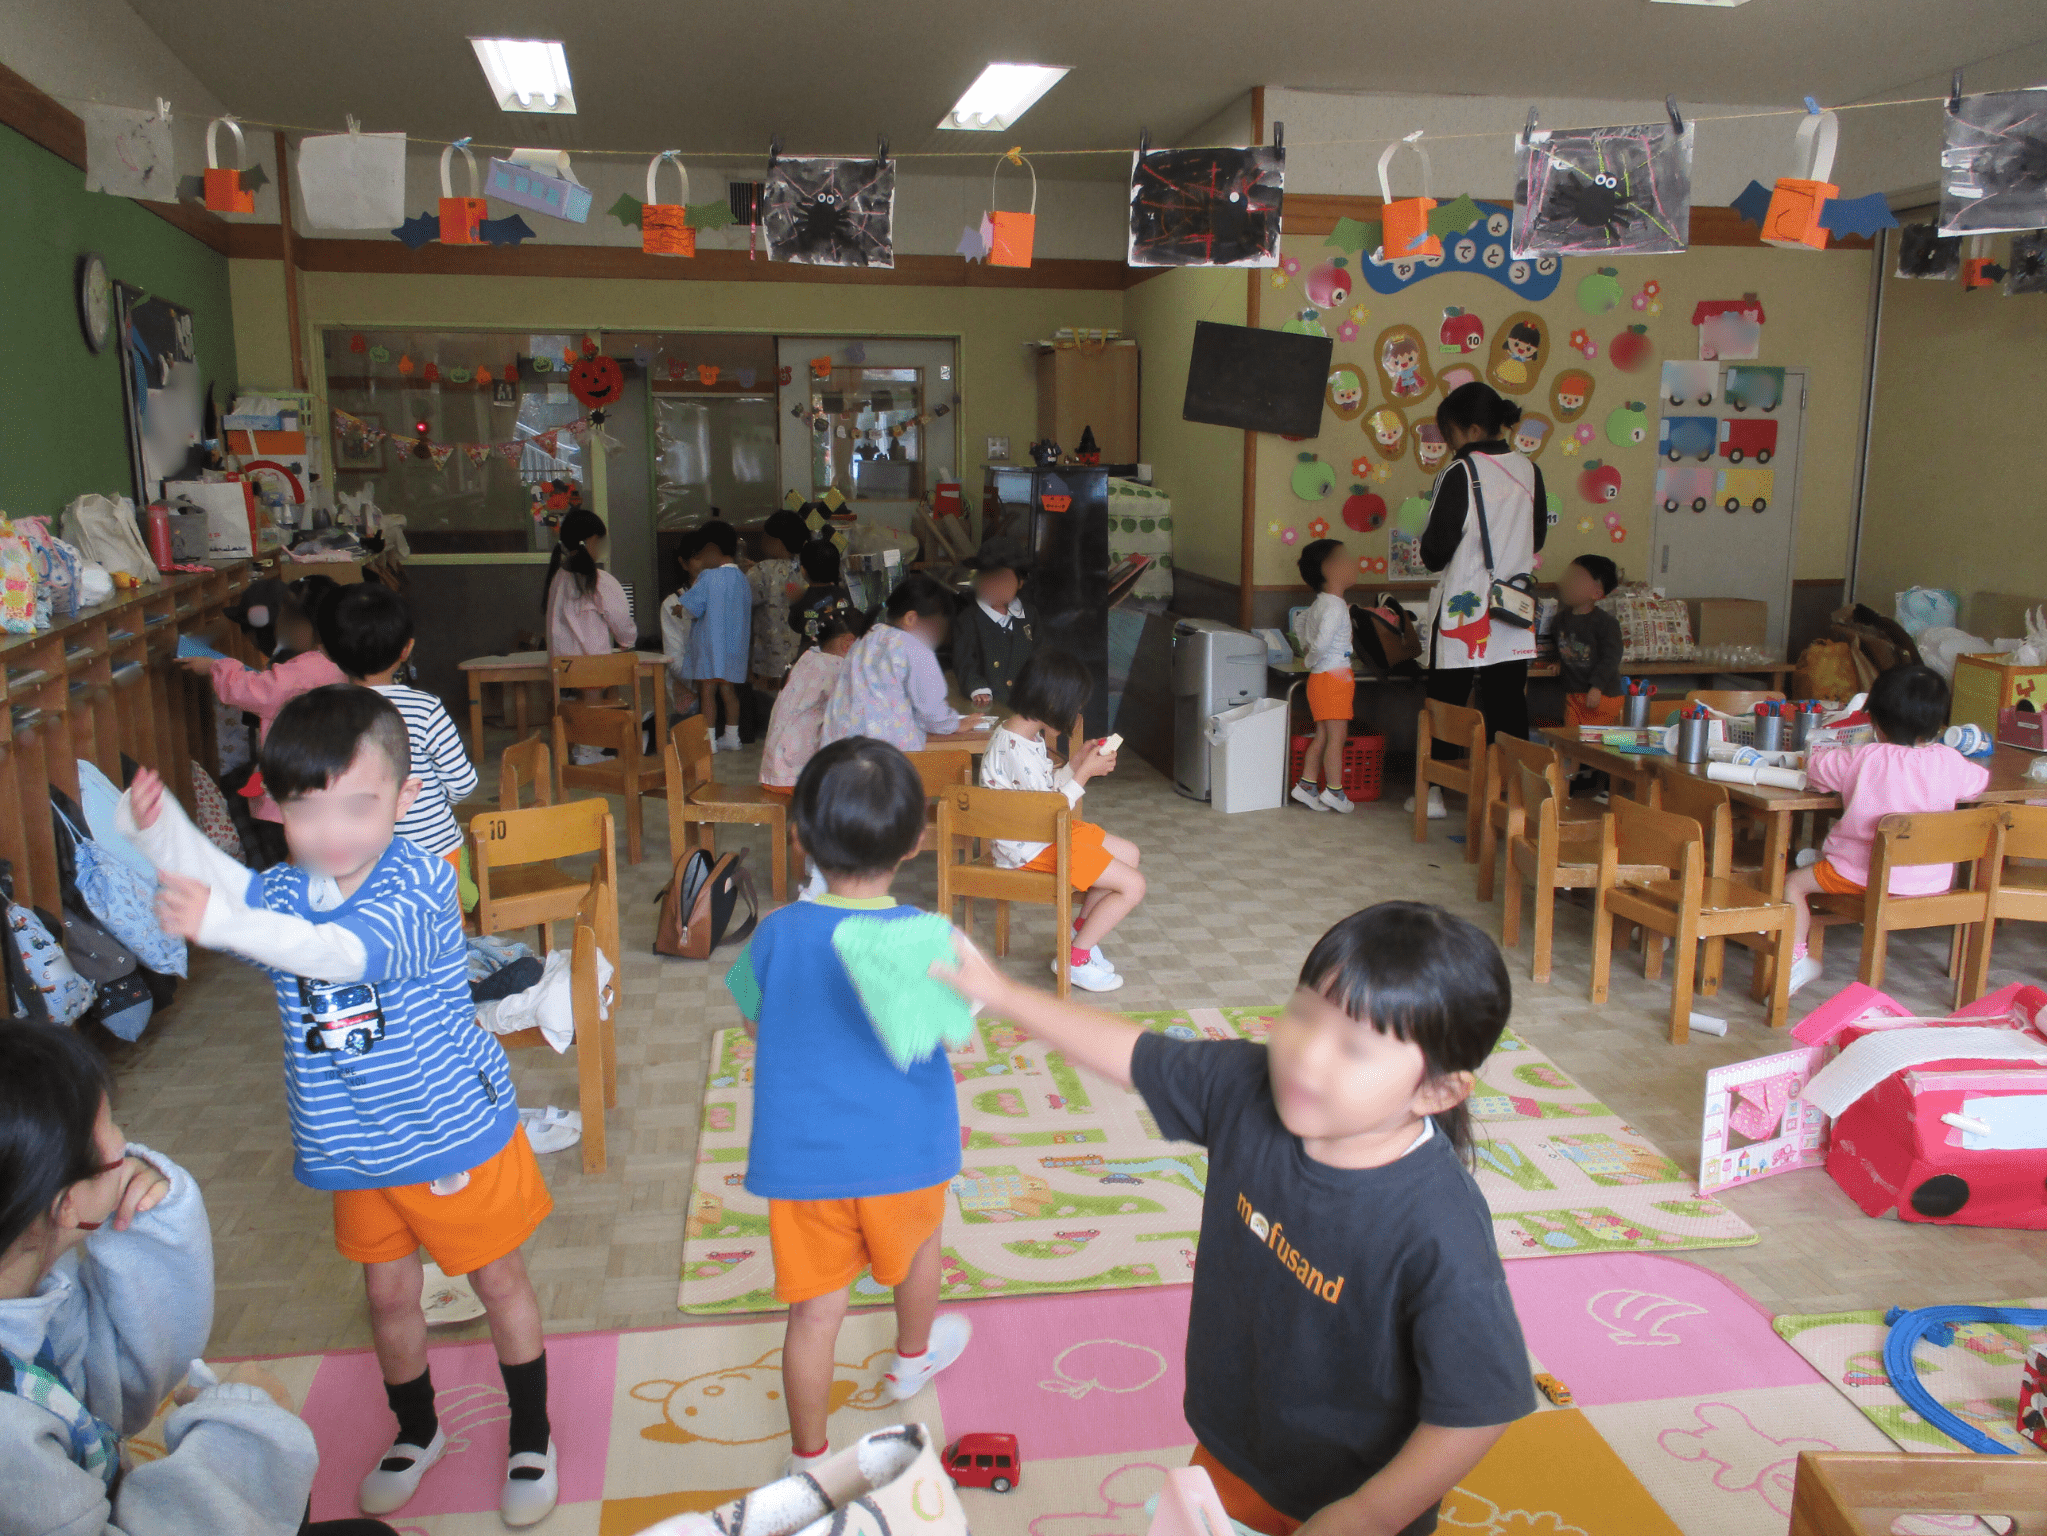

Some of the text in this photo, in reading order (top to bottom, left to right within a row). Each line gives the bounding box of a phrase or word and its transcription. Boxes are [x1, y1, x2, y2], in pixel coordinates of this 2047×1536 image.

[1398, 245, 1526, 280] おでとう
[1335, 291, 1343, 300] 4
[1467, 336, 1480, 345] 10
[1634, 430, 1640, 440] 1
[1546, 514, 1558, 523] 11
[560, 659, 573, 673] 7
[489, 819, 507, 841] 10
